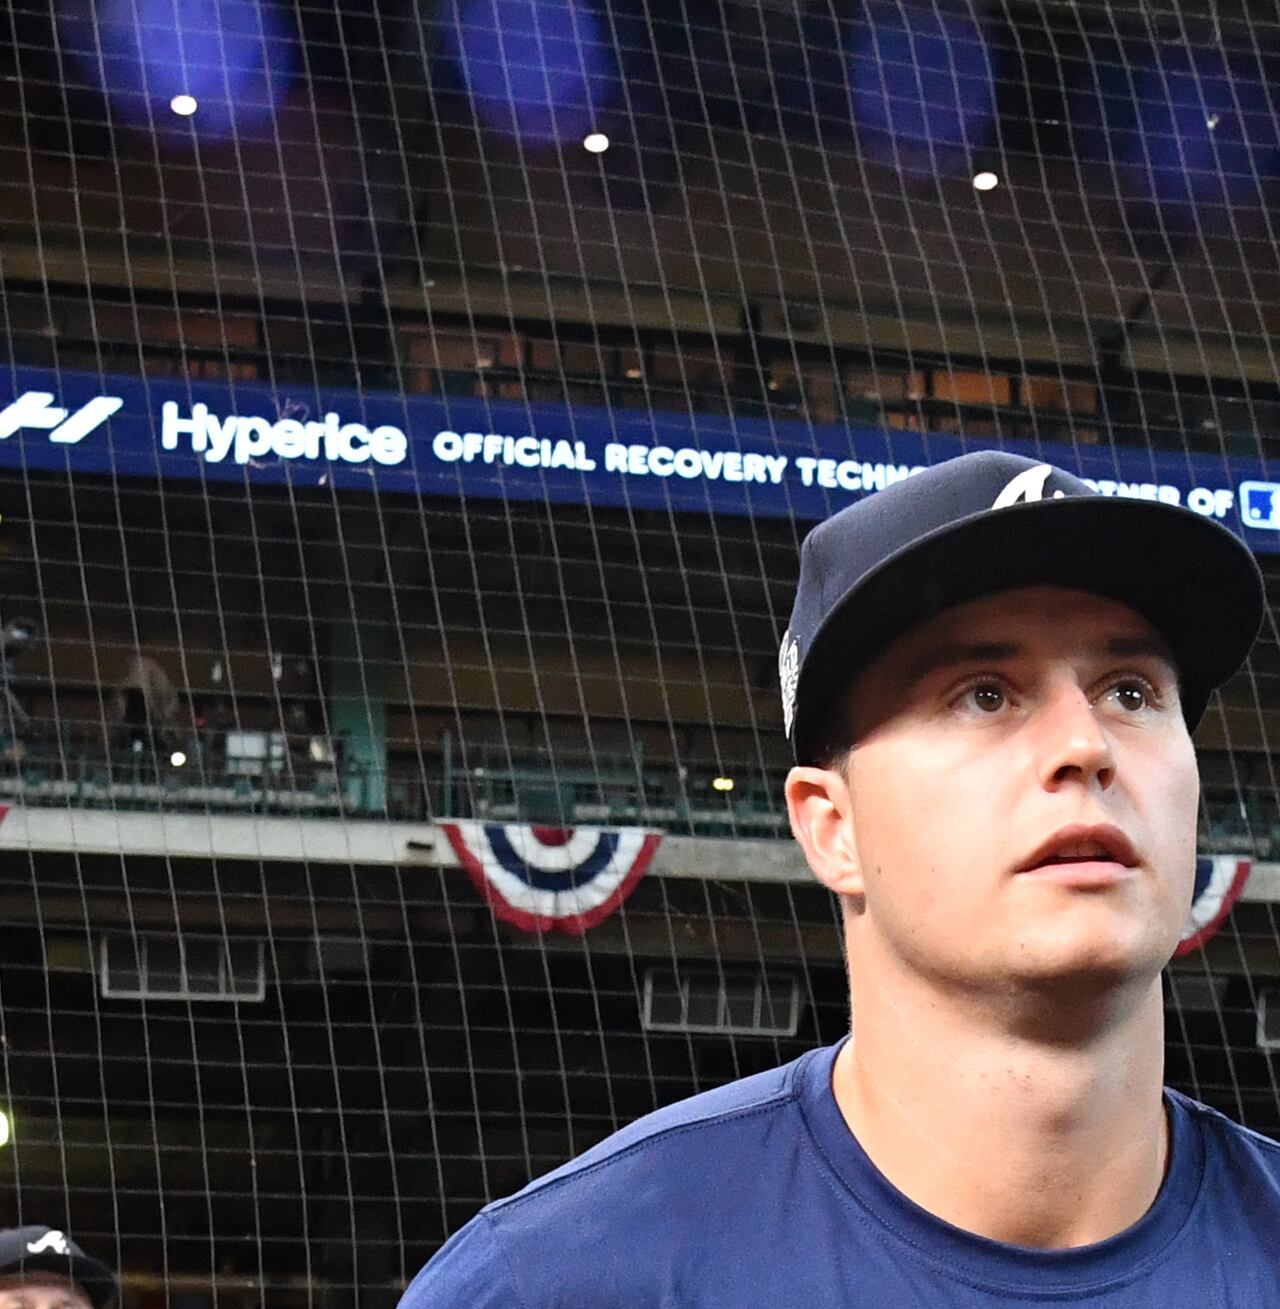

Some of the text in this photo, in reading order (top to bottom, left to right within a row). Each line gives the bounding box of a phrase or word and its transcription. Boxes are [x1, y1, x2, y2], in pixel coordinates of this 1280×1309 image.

[161, 400, 408, 466] Hyperice
[432, 430, 597, 472] OFFICIAL
[604, 442, 789, 484] RECOVERY
[795, 456, 930, 491] TECHN
[1187, 487, 1234, 518] OF
